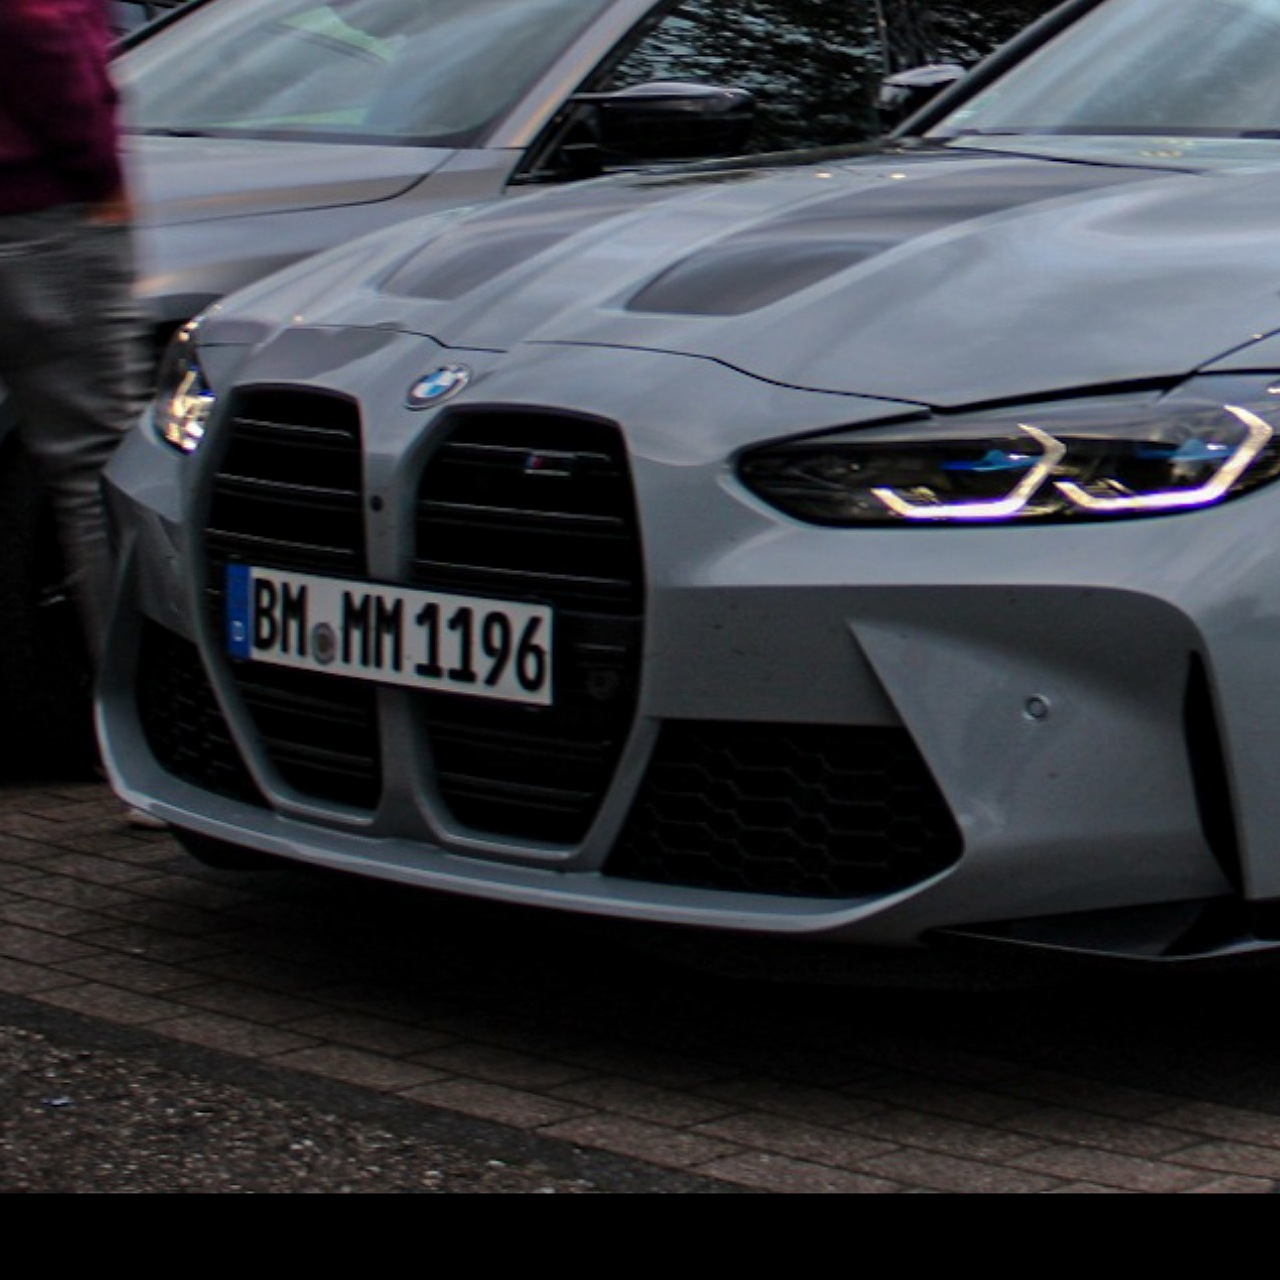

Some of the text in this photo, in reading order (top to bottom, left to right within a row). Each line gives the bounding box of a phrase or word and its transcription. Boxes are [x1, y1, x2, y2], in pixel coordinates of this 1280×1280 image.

[253, 577, 548, 693] BM MM 1196
